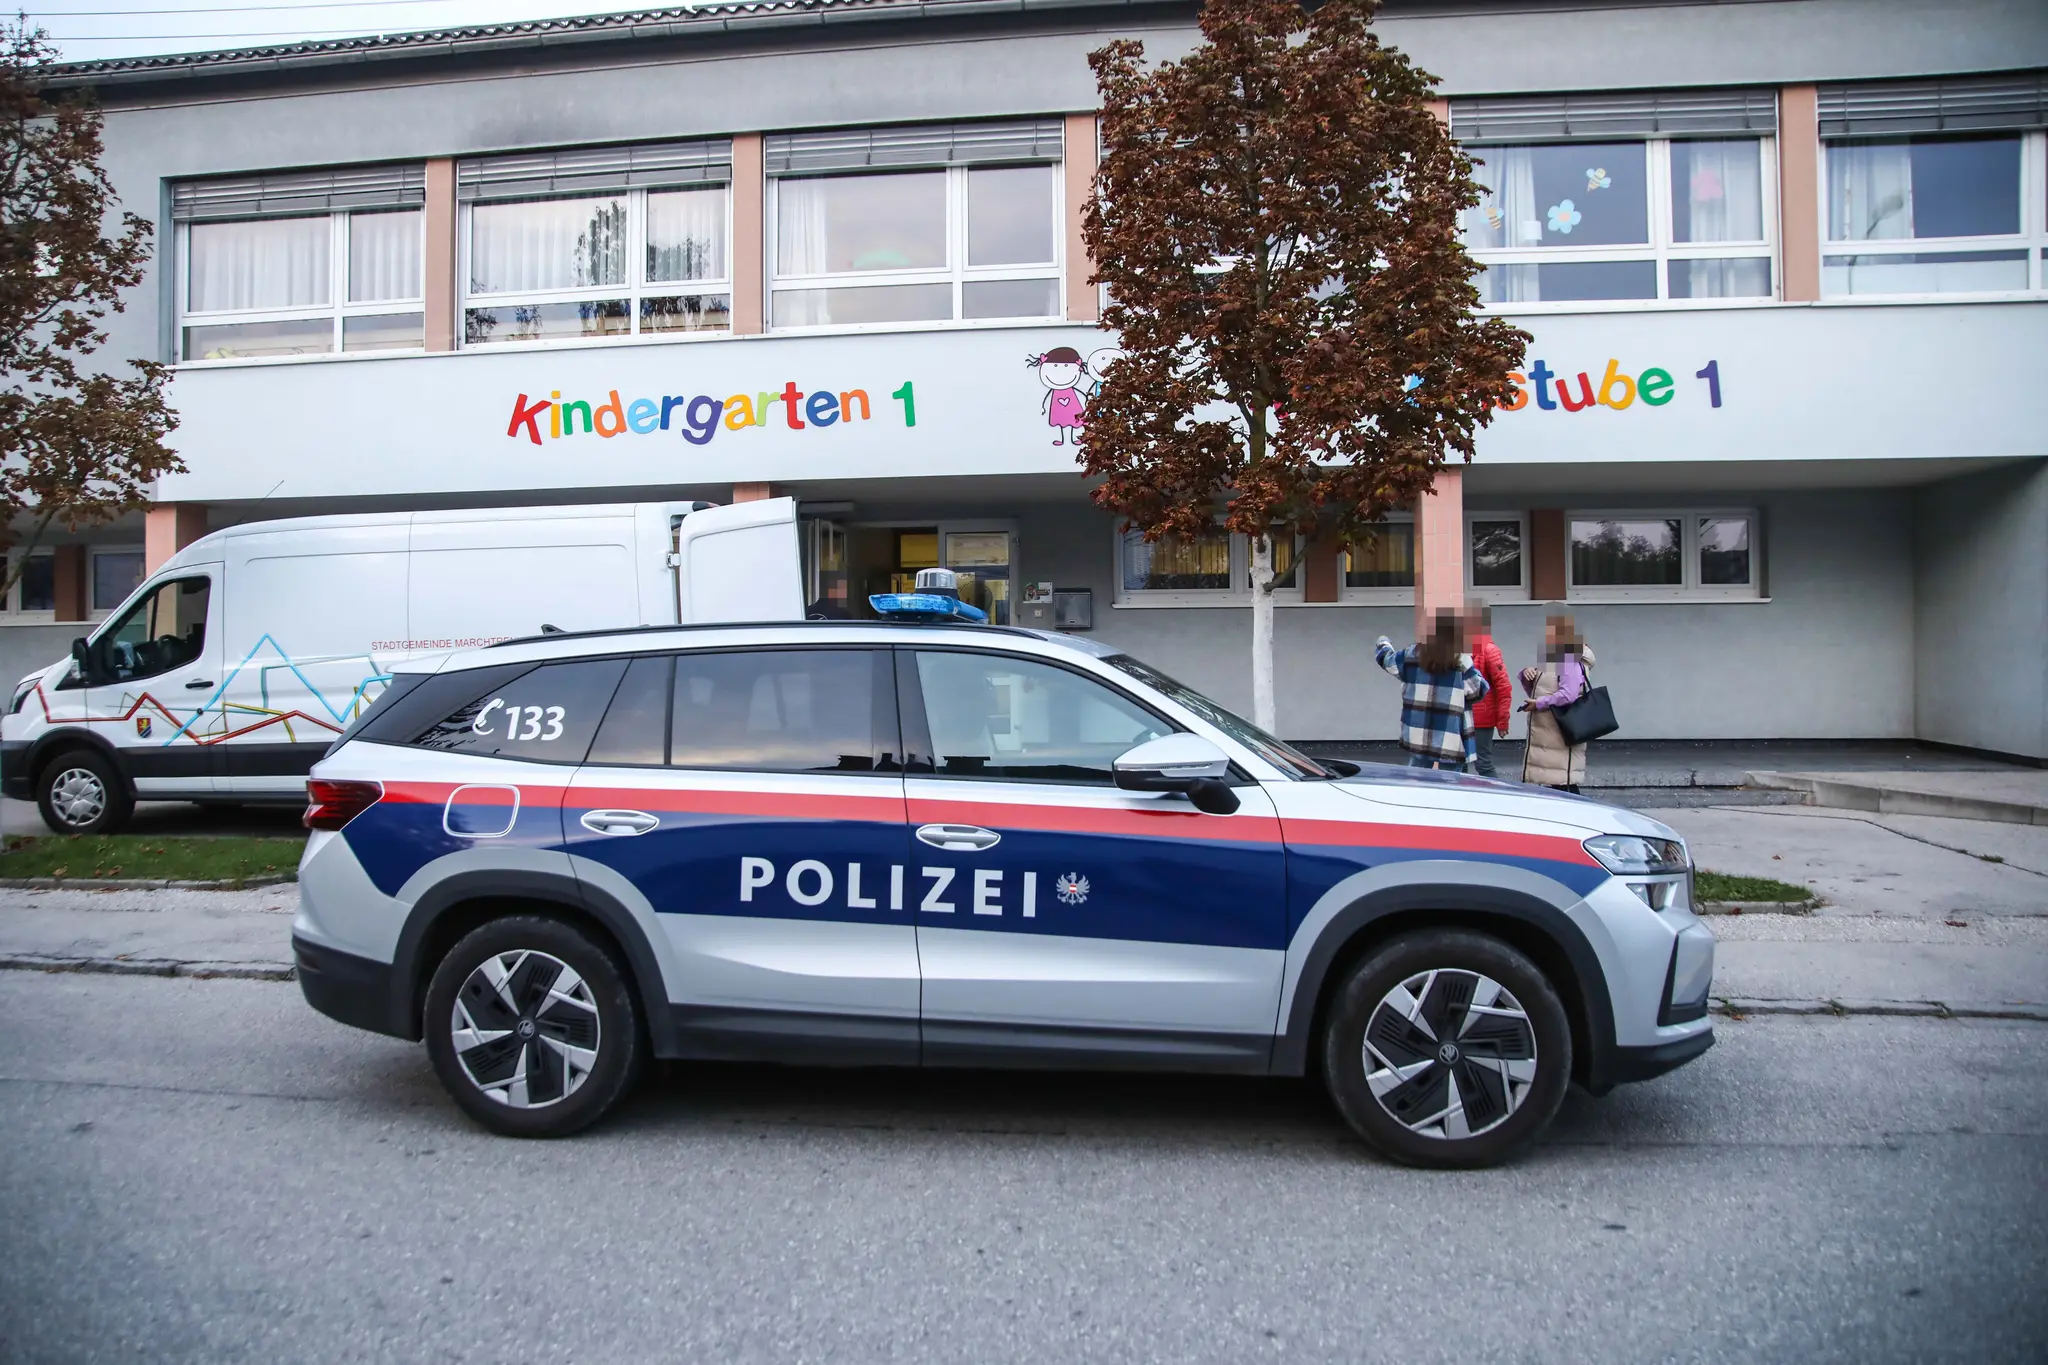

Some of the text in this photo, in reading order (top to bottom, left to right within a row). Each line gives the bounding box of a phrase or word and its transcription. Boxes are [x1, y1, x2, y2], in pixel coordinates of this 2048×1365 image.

[1696, 359, 1722, 408] 1
[507, 381, 917, 446] Kindergarten 1
[371, 636, 519, 651] STADTGEMEINDE MARCHTR
[505, 705, 566, 741] 133
[740, 856, 1037, 918] POLIZEI
